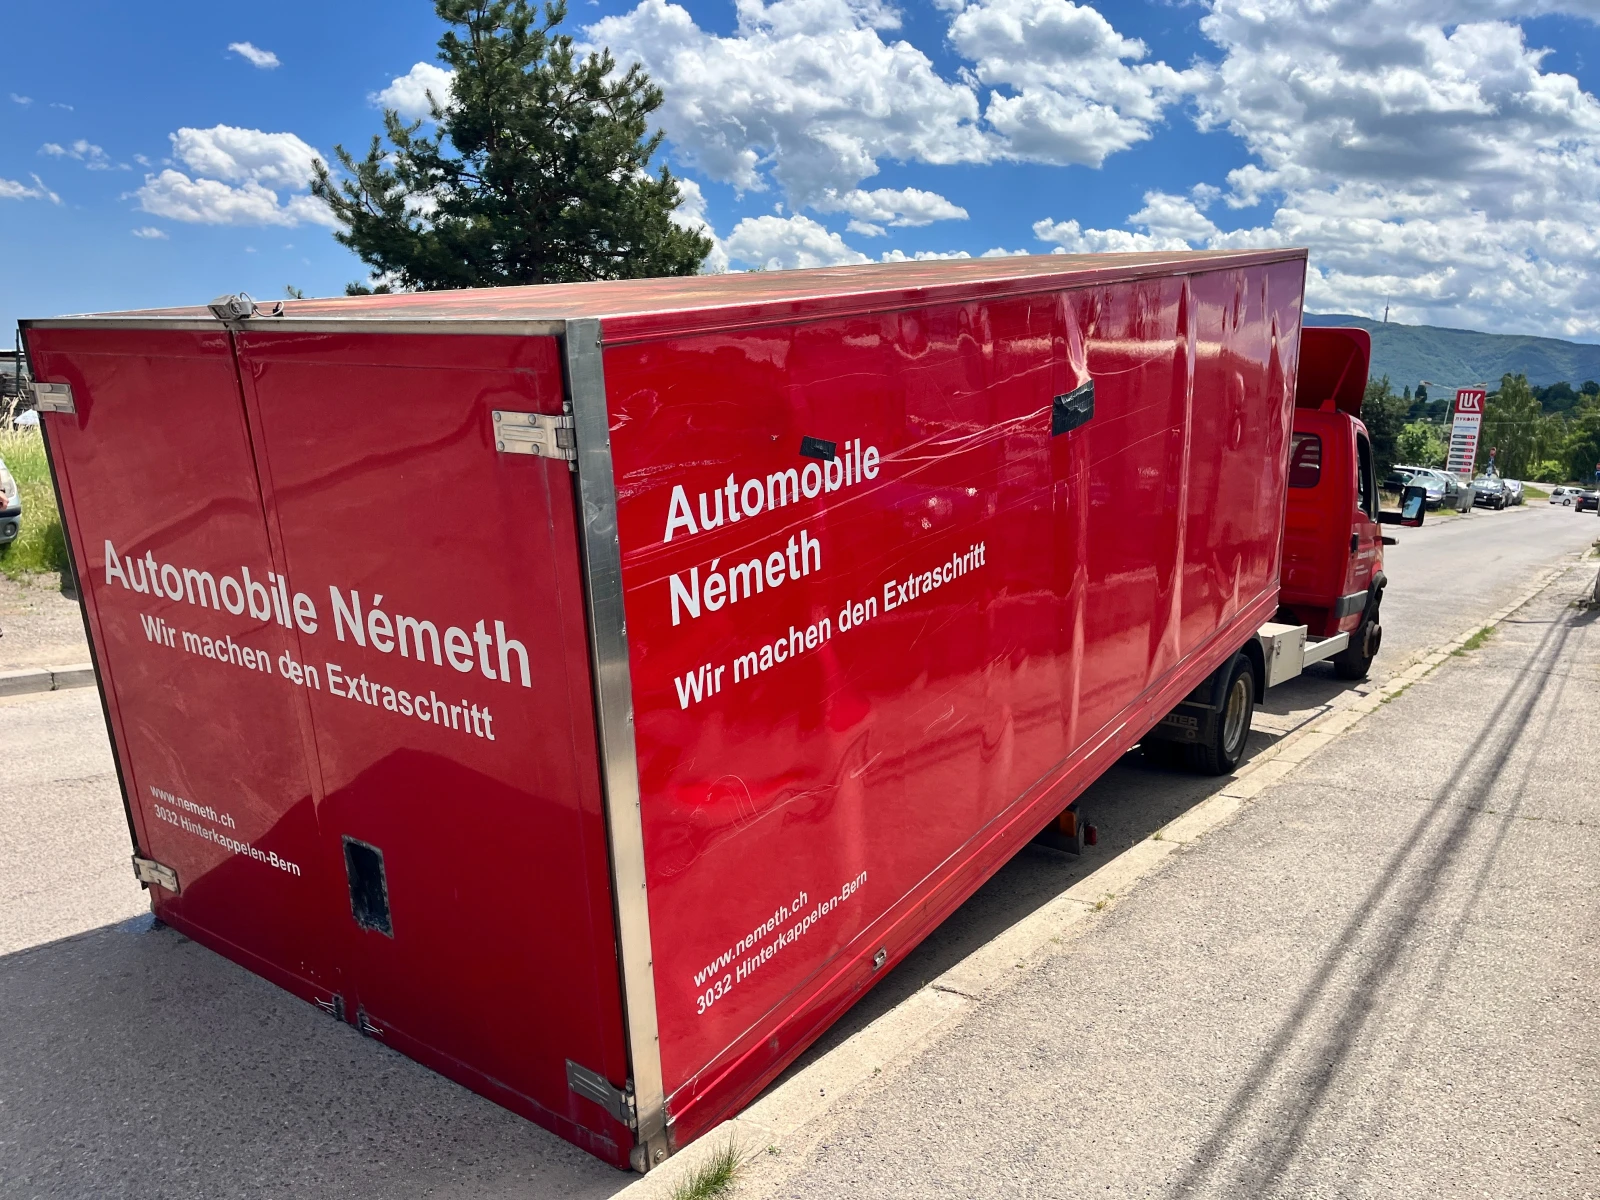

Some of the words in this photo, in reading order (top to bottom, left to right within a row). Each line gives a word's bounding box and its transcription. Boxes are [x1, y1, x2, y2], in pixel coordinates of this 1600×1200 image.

[663, 437, 880, 543] Automobile
[104, 539, 318, 635] Automobile
[329, 585, 532, 688] Németh
[669, 529, 822, 627] Németh
[674, 662, 726, 711] Wir
[733, 617, 832, 684] machen
[838, 596, 878, 634] den
[883, 540, 987, 613] Extraschritt
[140, 613, 177, 649] Wir
[182, 631, 272, 675] machen
[278, 650, 320, 690] den
[326, 662, 496, 741] Extraschritt
[150, 785, 236, 830] www.nemeth.ch
[154, 803, 179, 827] 3032
[180, 815, 301, 877] Hinterkappelen-Bern
[693, 890, 808, 988] www.nemeth.ch
[696, 974, 732, 1015] 3032
[735, 870, 868, 984] Hinterkappelen-Bern
